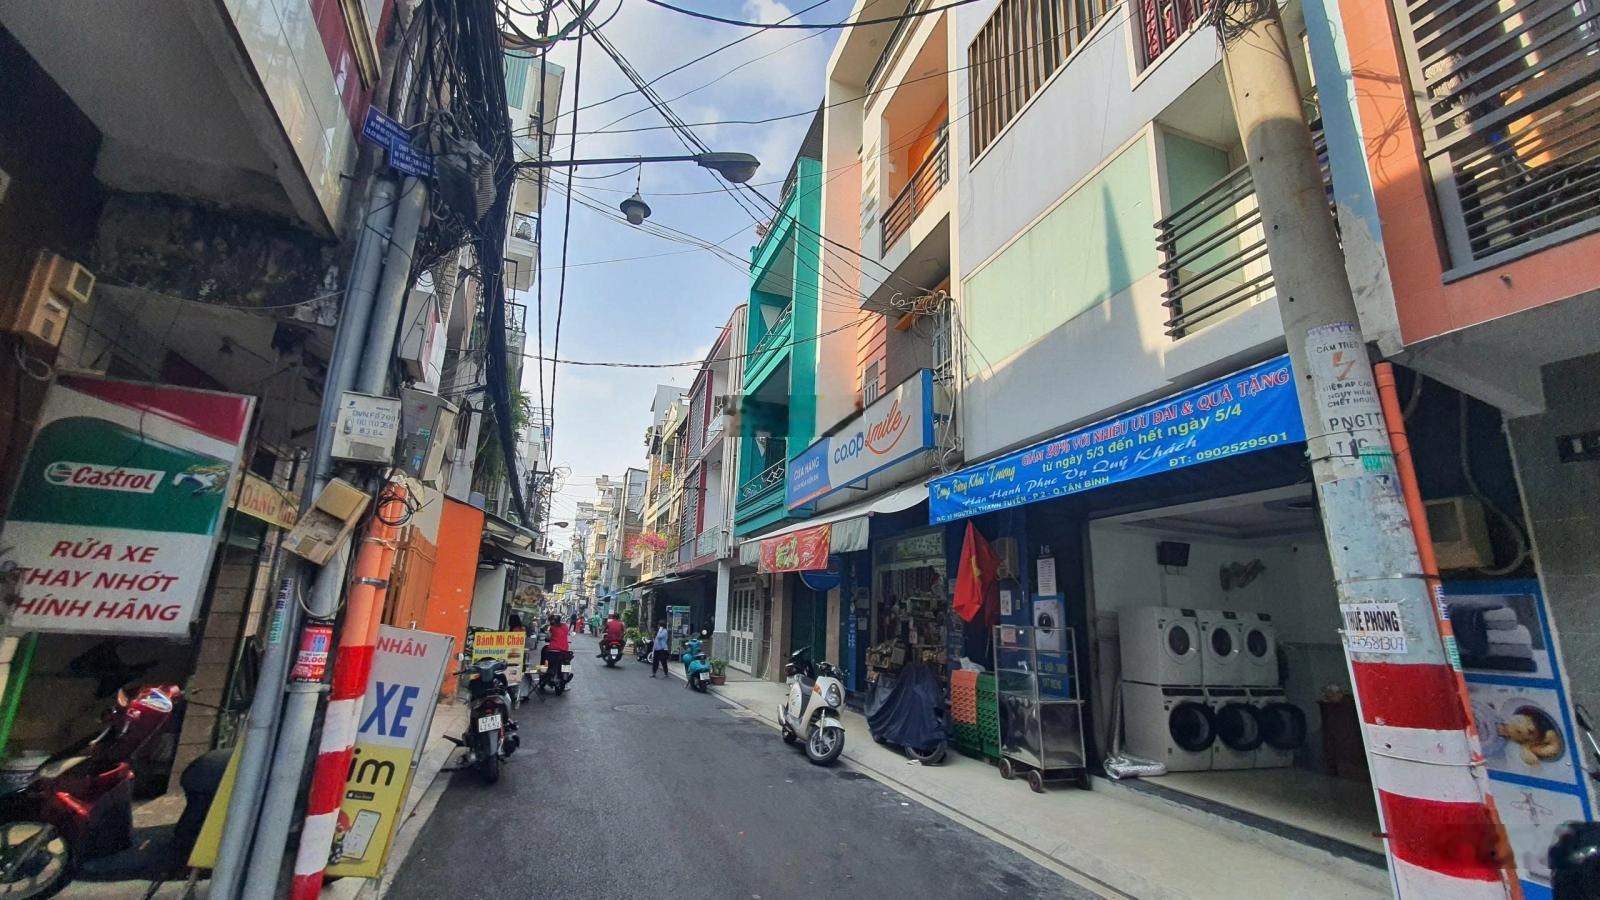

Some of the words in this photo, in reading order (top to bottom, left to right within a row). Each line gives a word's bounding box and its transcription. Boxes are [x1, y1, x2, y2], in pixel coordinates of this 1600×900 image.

[1181, 400, 1194, 416] &
[1237, 367, 1290, 398] TẶNG
[1056, 454, 1083, 469] ngày
[1086, 445, 1104, 460] 5/3
[1108, 437, 1134, 454] đến
[1138, 425, 1164, 444] hết
[1167, 415, 1210, 437] ngày
[1215, 403, 1242, 422] 5/4
[1134, 434, 1198, 464] Khách
[1196, 432, 1288, 461] 0902529501
[71, 466, 157, 490] Castrol
[50, 537, 111, 560] RỬA
[119, 546, 159, 563] XE
[15, 566, 91, 588] THAY
[93, 570, 179, 593] NHỚT
[12, 593, 90, 618] HÍNH
[93, 598, 182, 622] HÃNG
[1364, 605, 1401, 632] PHÒNG
[376, 636, 428, 658] NHÂN
[358, 681, 419, 738] XE
[346, 747, 396, 787] im
